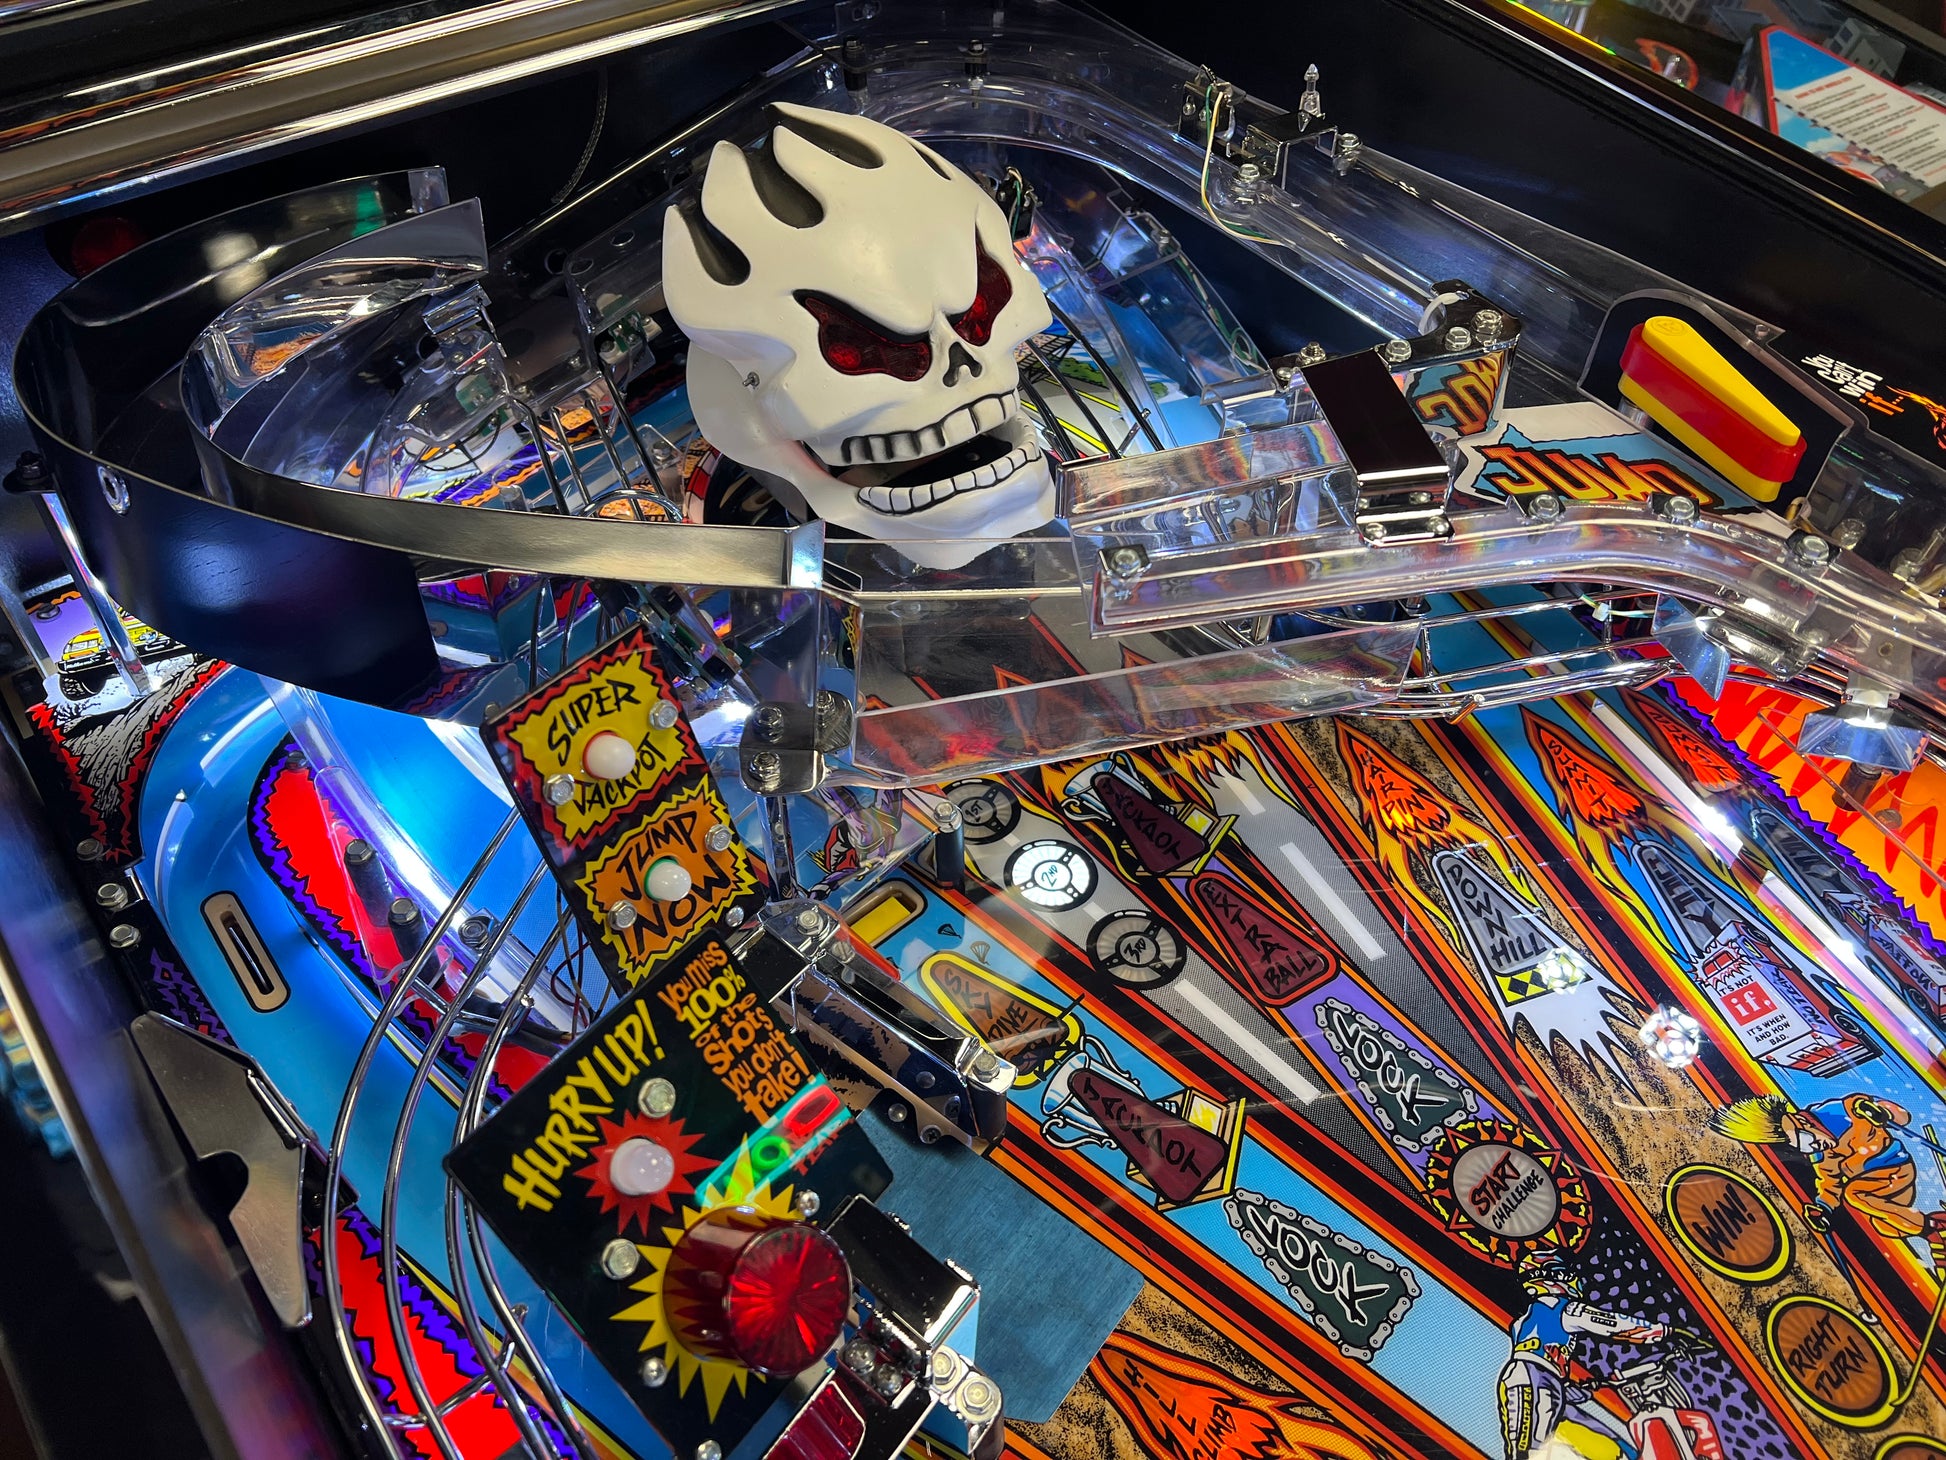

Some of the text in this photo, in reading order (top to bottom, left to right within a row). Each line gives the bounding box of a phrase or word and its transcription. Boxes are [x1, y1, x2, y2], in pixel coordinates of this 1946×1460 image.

[547, 678, 642, 767] SUPER
[572, 731, 668, 816] JACKPOT
[1361, 750, 1402, 801] HAIR
[1382, 793, 1427, 819] PIN
[1548, 739, 1609, 812] SUMMIT
[965, 800, 984, 823] 1ST
[1102, 776, 1182, 861] JACKPOT
[615, 810, 698, 902] JUMP
[1041, 864, 1059, 888] 2ND
[628, 853, 732, 957] NOW
[1203, 880, 1289, 963] EXTRA
[1447, 863, 1509, 941] DOWN
[684, 941, 729, 985] miss
[1123, 937, 1148, 964] 3RD
[1263, 950, 1318, 995] BALL
[1488, 932, 1548, 970] HILL
[1735, 975, 1755, 990] NOT
[680, 964, 747, 1041] 100%
[695, 993, 757, 1049] of the
[943, 969, 994, 1021] SKY
[987, 1000, 1029, 1048] DIVE
[1746, 1013, 1787, 1037] IT'S WHEN
[721, 1029, 795, 1103] you don't
[1754, 1021, 1791, 1043] AND HOW
[1769, 1034, 1790, 1046] BAD.
[744, 1051, 817, 1129] take!
[1332, 1009, 1451, 1128] LOCK
[502, 999, 666, 1213] HURRY UP!
[1080, 1077, 1203, 1178] JACKPOT
[1467, 1149, 1522, 1217] START
[1491, 1168, 1545, 1231] CHALLENGE
[1690, 1182, 1757, 1258] WIN!
[1245, 1203, 1391, 1328] LOCK
[1788, 1311, 1842, 1379] RIGHT
[1813, 1335, 1870, 1401] TURN
[1123, 1358, 1198, 1437] HILL
